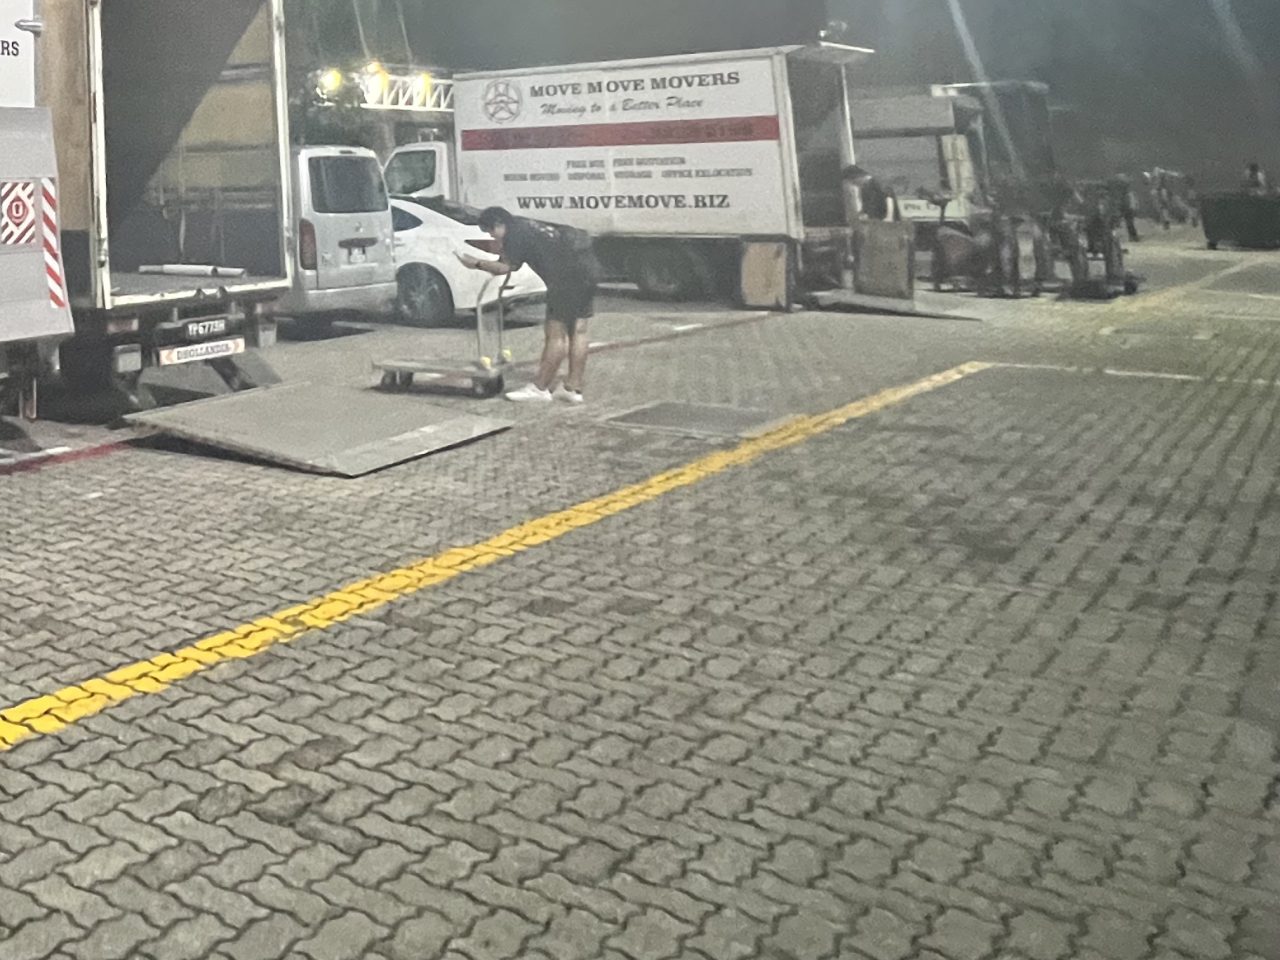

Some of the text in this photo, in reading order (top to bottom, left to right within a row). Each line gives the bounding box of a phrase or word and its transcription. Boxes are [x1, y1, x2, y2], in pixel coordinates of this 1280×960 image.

[530, 71, 740, 98] MOVE MOVE MOVERS
[539, 102, 587, 117] Moving
[591, 101, 602, 113] to
[666, 95, 704, 108] Place
[517, 194, 730, 210] WWW.MOVEMOVE.BIZ
